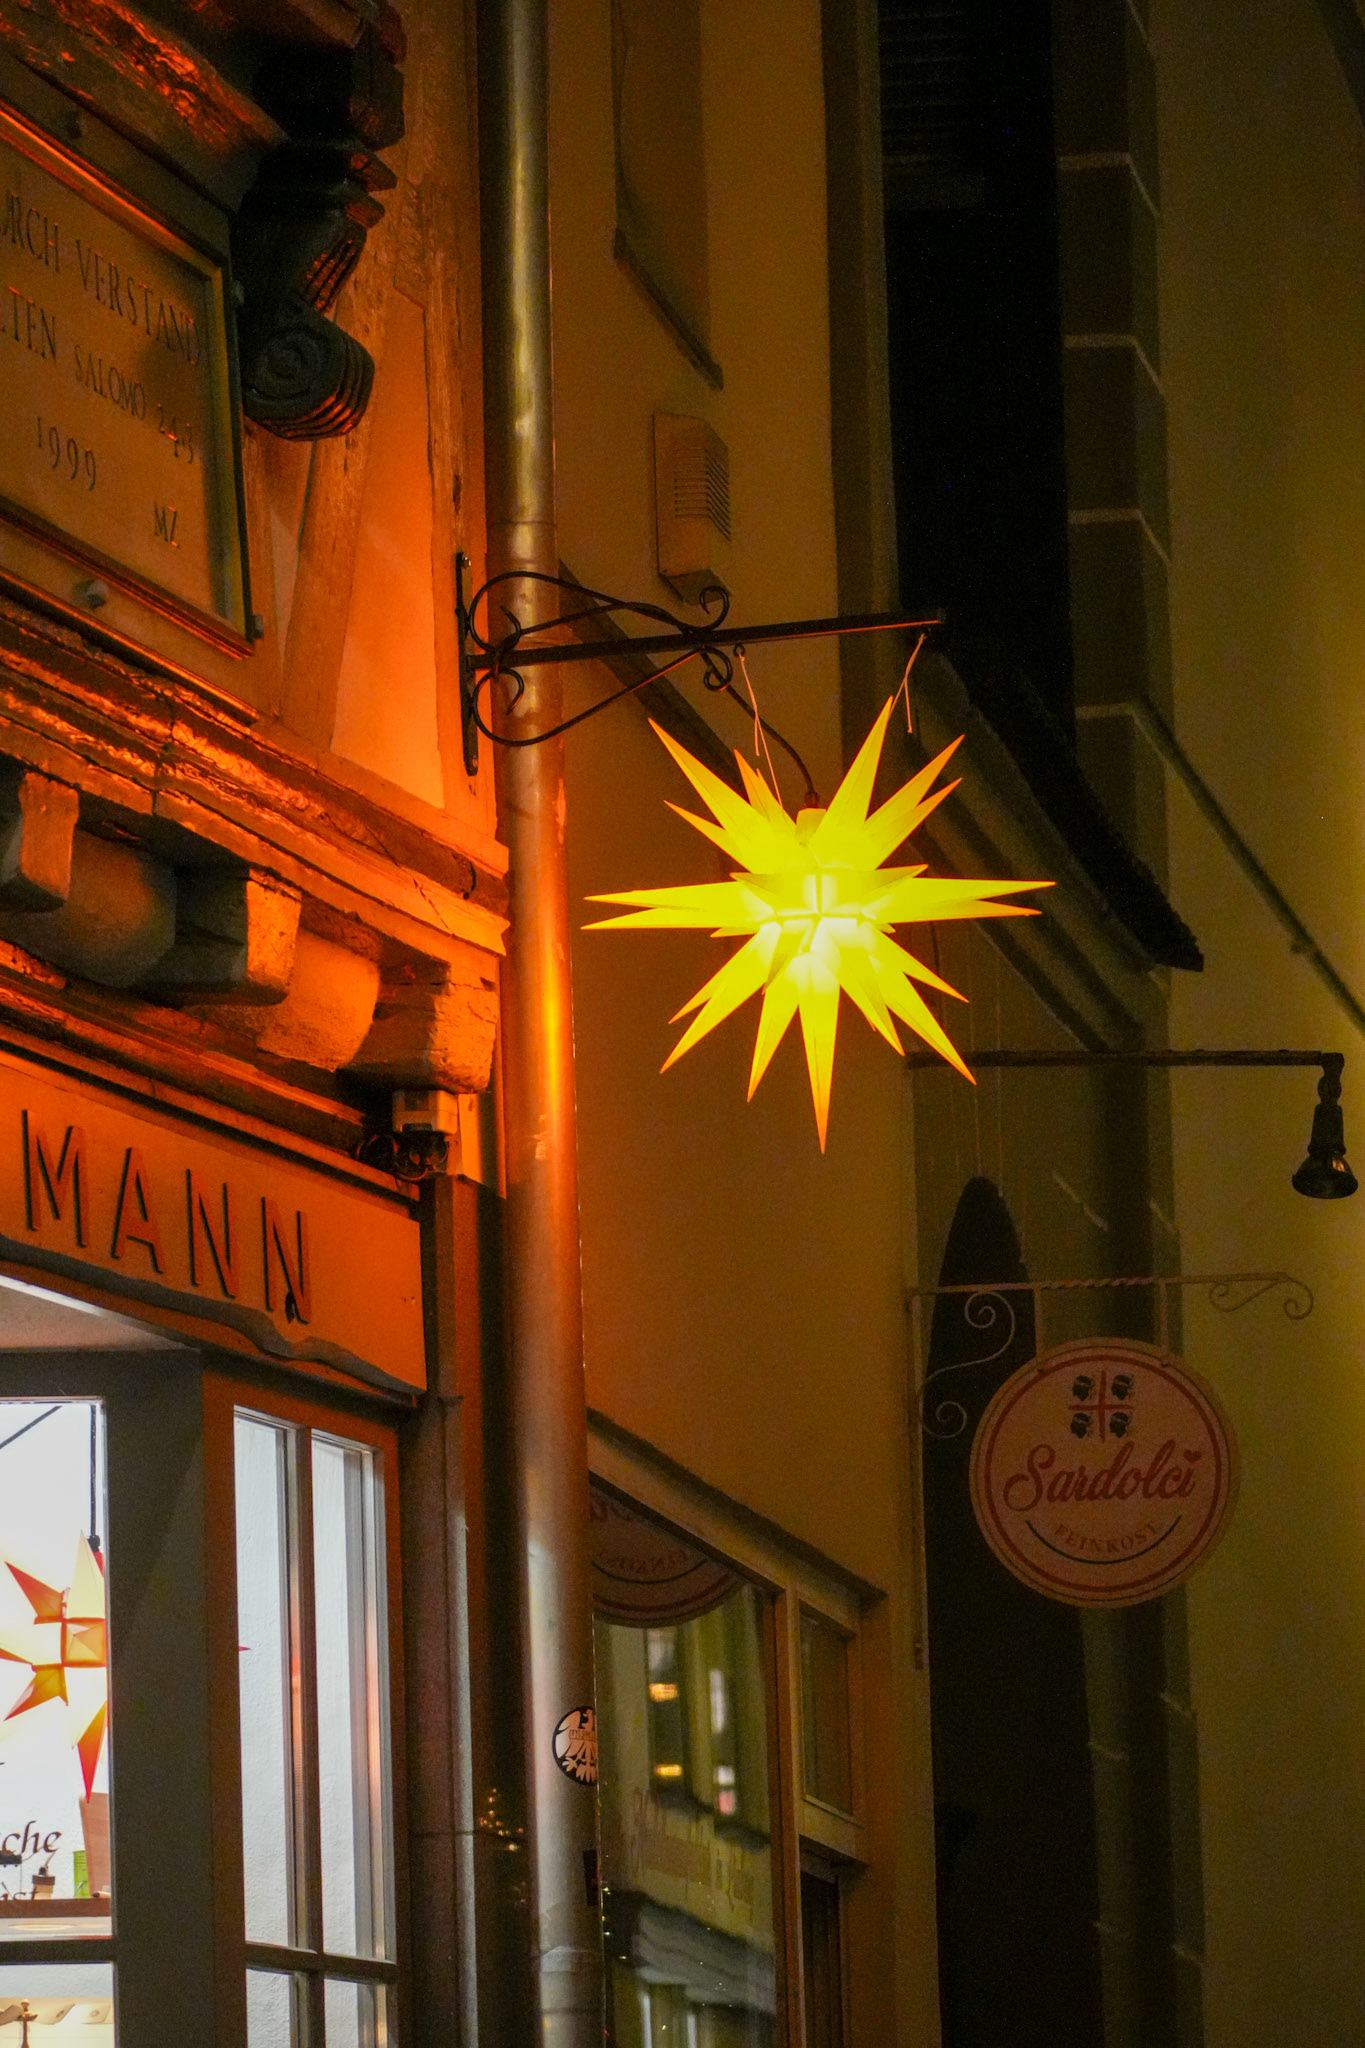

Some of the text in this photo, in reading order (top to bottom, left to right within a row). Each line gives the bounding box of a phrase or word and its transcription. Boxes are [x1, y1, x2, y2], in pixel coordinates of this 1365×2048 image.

[75, 237, 200, 367] VERSTAND
[0, 284, 57, 364] TEN
[74, 344, 146, 421] SALOMO
[36, 416, 97, 491] 1999
[21, 1109, 309, 1324] MANN
[1003, 1439, 1201, 1512] Sardolci
[1053, 1519, 1158, 1553] FEINKOST
[0, 1820, 62, 1854] che
